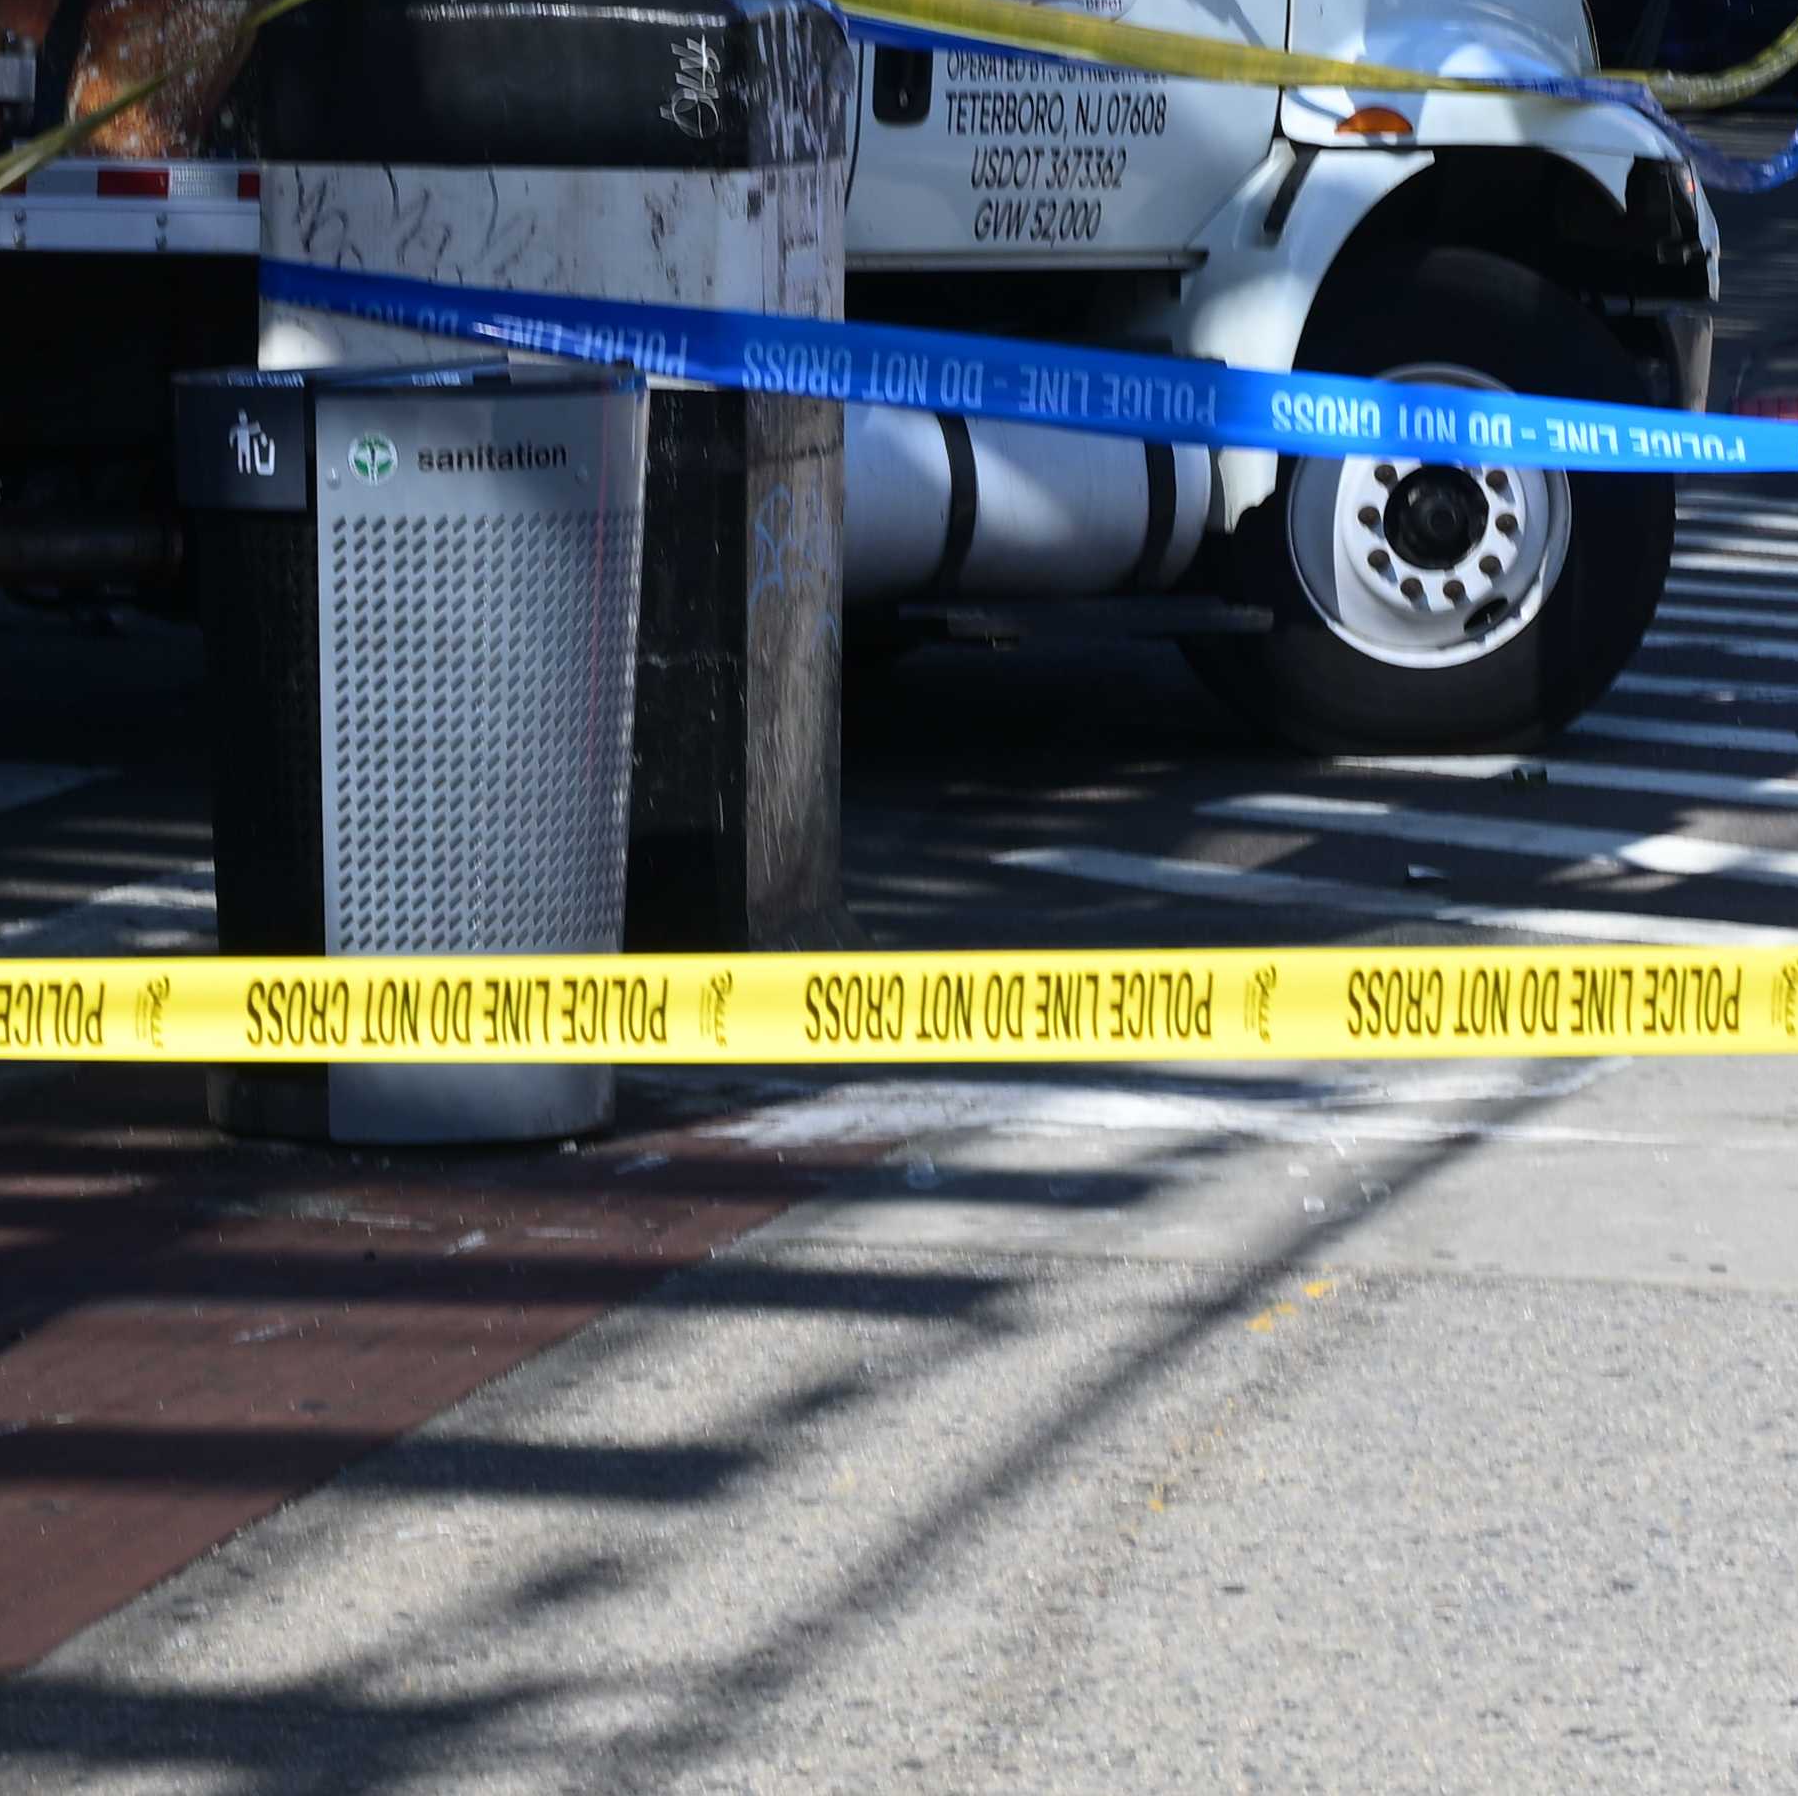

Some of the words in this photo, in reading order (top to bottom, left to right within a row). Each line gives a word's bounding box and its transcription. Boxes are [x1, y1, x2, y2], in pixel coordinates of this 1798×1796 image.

[945, 91, 1068, 143] TETERBORO,
[1075, 91, 1103, 136] NJ
[1107, 92, 1167, 136] 07608
[970, 145, 1045, 190] USDOT
[974, 197, 1030, 242] GVW
[1029, 198, 1102, 248] 52,000
[741, 340, 852, 398] CROSS
[861, 351, 929, 406] NOT
[940, 357, 984, 409] DO
[1019, 363, 1089, 417] LINE
[1102, 372, 1217, 428] POLICE
[417, 438, 568, 473] sanitation
[1468, 409, 1514, 449] DO
[1545, 417, 1620, 457] LINE
[246, 981, 350, 1043] CROSS
[361, 980, 421, 1043] NOT
[430, 980, 473, 1042] DO
[483, 980, 551, 1042] LINE
[561, 978, 668, 1042] POLICE
[805, 975, 905, 1040] CROSS
[916, 975, 974, 1039] NOT
[984, 975, 1025, 1038] DO
[1036, 974, 1100, 1037] LINE
[1110, 972, 1213, 1037] POLICE
[1347, 970, 1444, 1035] CROSS
[1453, 969, 1511, 1034] NOT
[1520, 969, 1560, 1033] DO
[1570, 969, 1634, 1032] LINE
[1643, 967, 1742, 1032] POLICE
